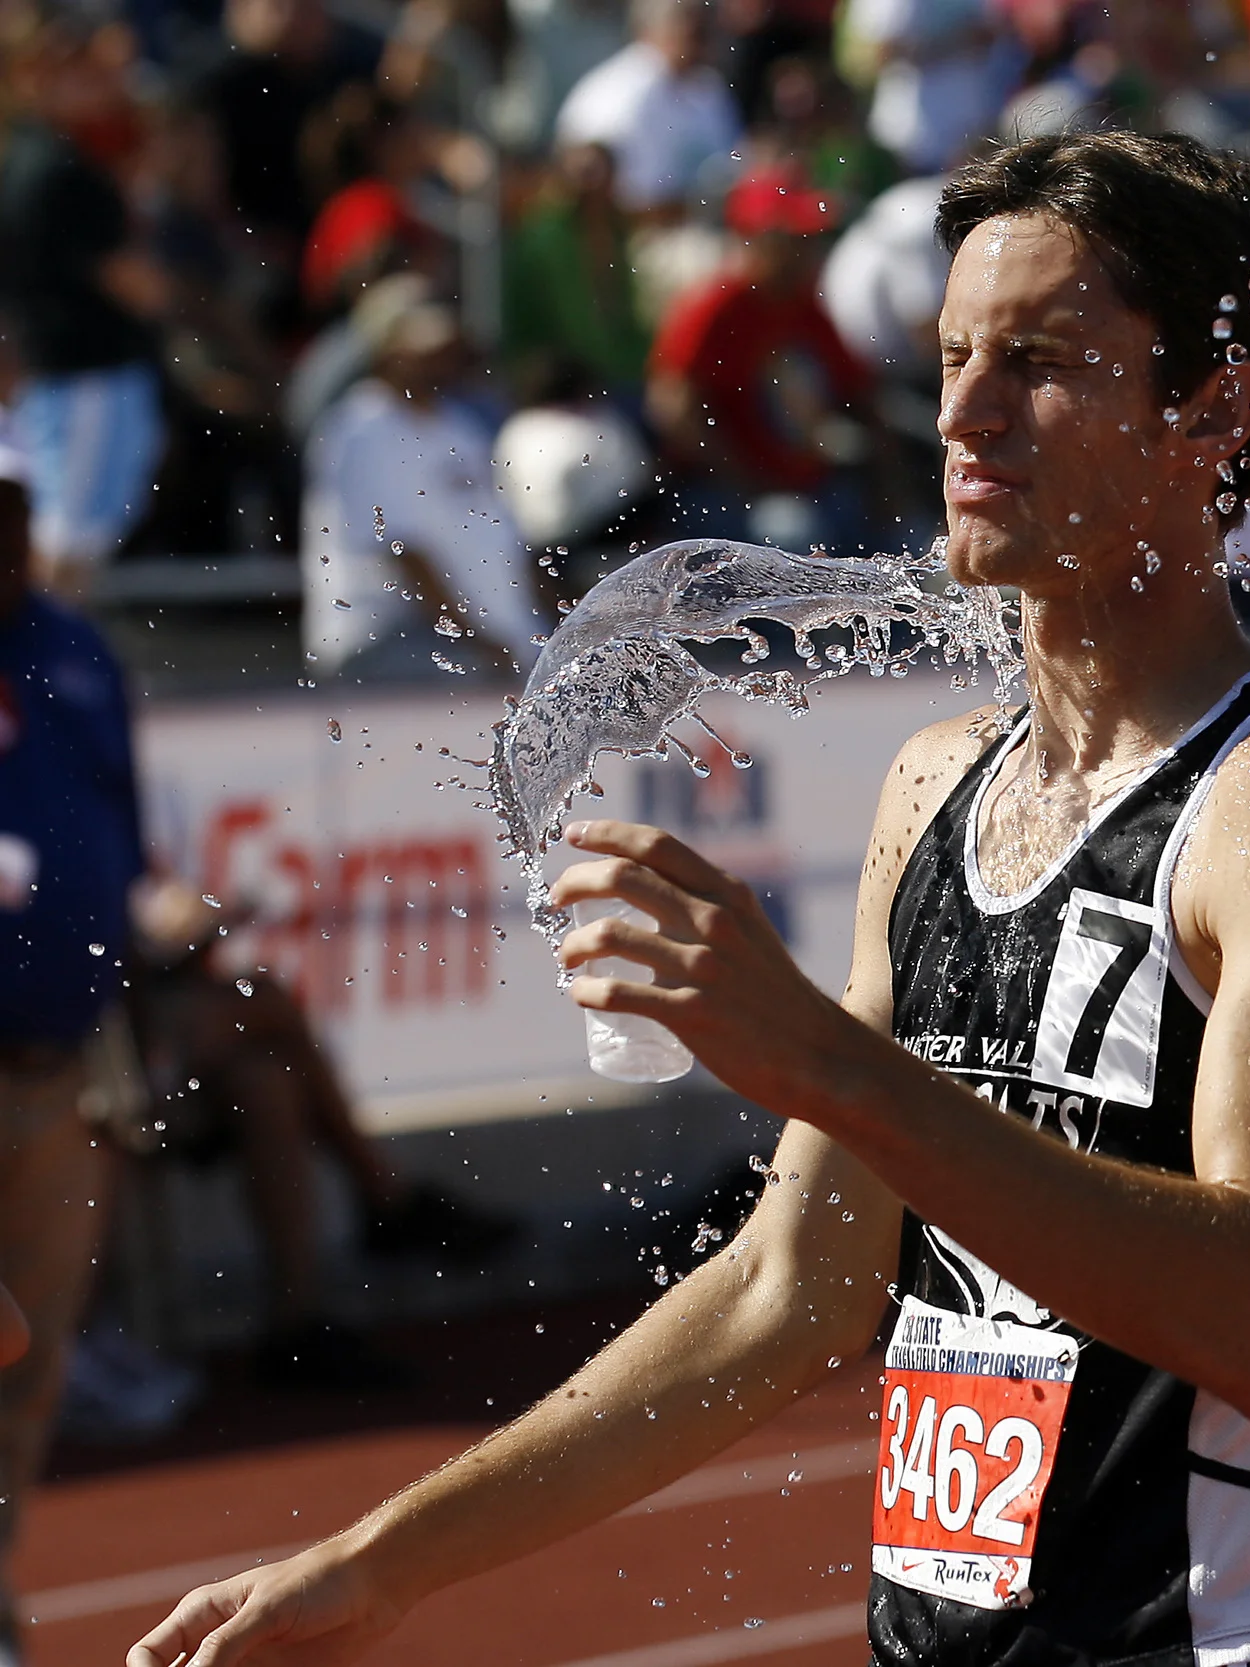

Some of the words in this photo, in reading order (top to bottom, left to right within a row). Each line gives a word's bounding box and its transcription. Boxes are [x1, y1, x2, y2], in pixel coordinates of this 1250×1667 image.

[1063, 907, 1153, 1079] 7
[938, 1349, 1066, 1381] CHAMPIONSHIPS
[880, 1384, 1045, 1546] 3462
[932, 1557, 992, 1585] RunTex
